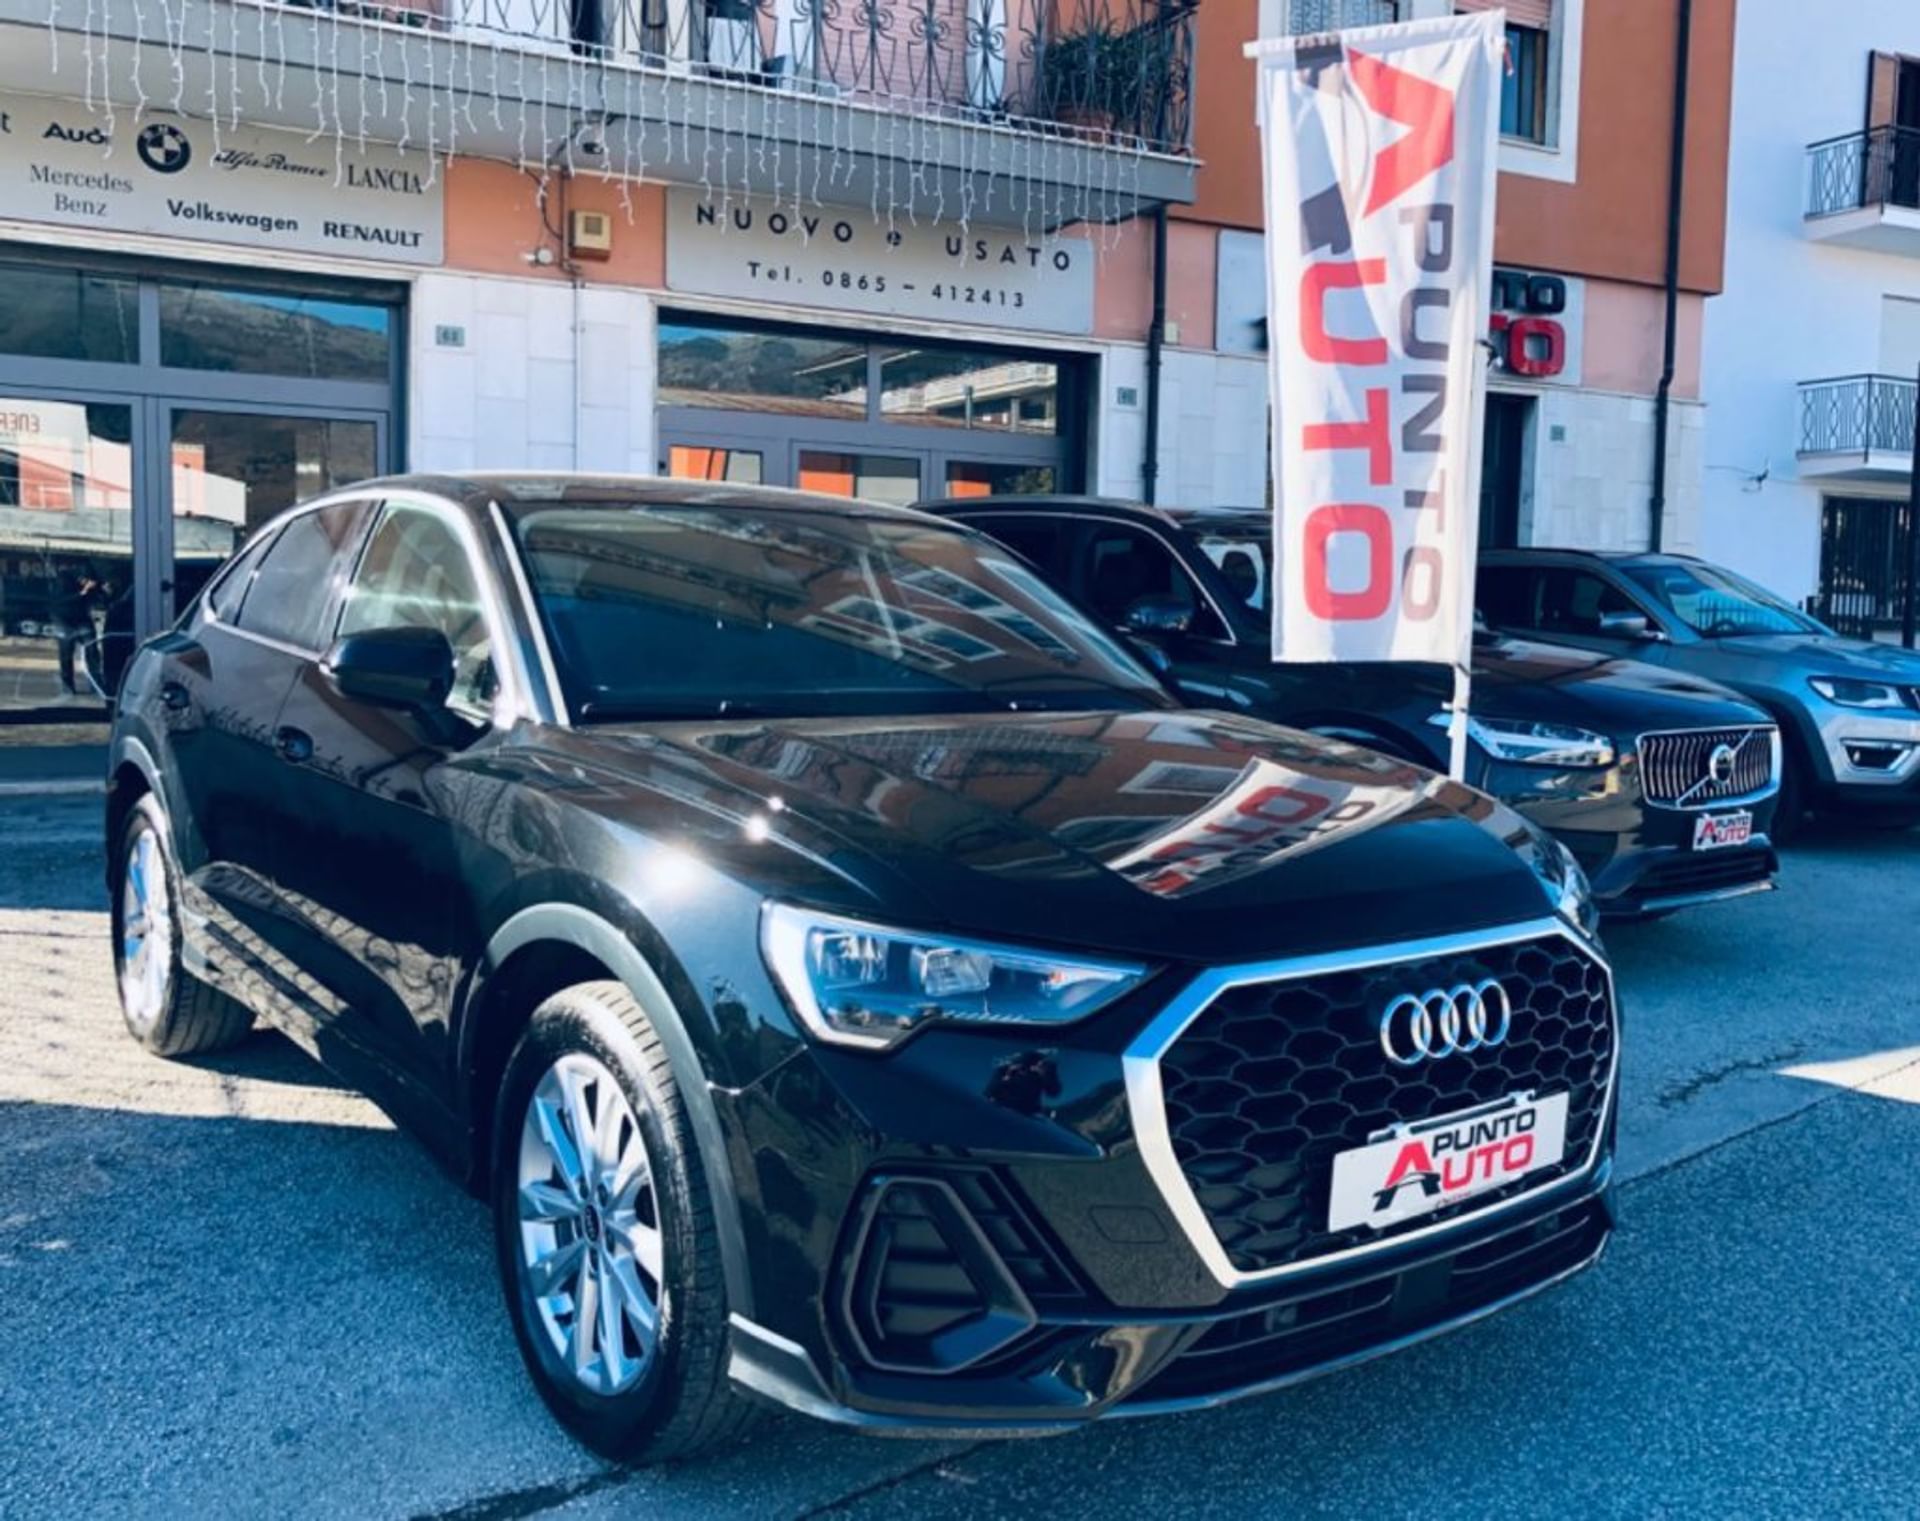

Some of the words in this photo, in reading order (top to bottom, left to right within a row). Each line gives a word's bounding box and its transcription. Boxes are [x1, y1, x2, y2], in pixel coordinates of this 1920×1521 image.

[30, 164, 134, 193] Mercedes
[347, 164, 423, 195] LANCIA
[54, 192, 108, 217] Benz
[167, 198, 299, 233] Volkswagen
[322, 220, 423, 248] RENAULT
[696, 203, 853, 243] NUOVO
[945, 236, 1070, 272] USATO
[747, 260, 802, 284] Tel.
[822, 269, 886, 293] 0865
[932, 283, 1024, 308] 412413
[1399, 203, 1454, 623] PUNTO
[1432, 1108, 1536, 1157] PUNTO
[1373, 1133, 1535, 1213] AUTO
